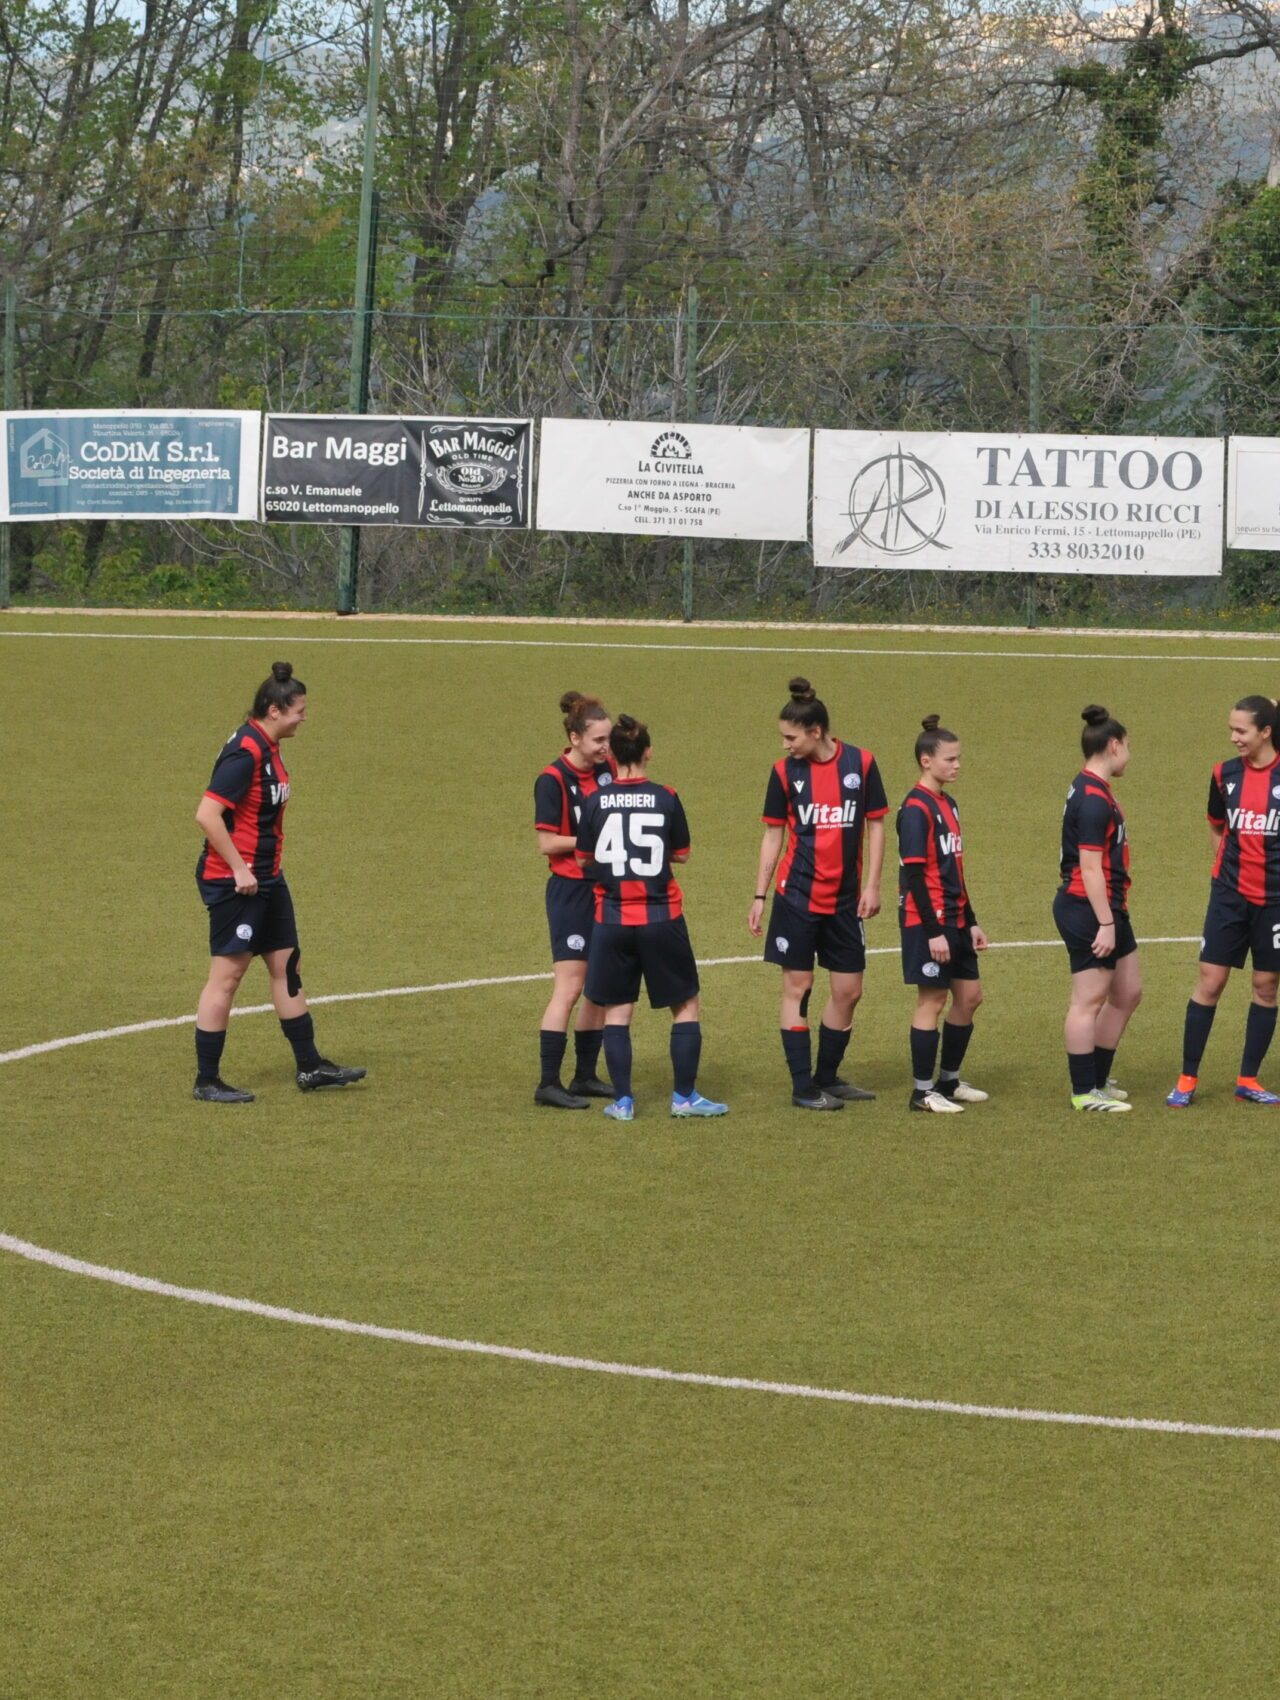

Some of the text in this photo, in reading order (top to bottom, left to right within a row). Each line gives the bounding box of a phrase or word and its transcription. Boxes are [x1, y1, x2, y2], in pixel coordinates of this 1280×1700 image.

[80, 441, 220, 462] CoDiM S.r.l.
[272, 435, 407, 466] Bar Maggi
[429, 437, 461, 459] BAR
[452, 452, 493, 462] OLD TIME
[69, 465, 231, 482] Società di Ingegneria
[638, 460, 704, 475] LA CIVITELLA
[976, 447, 1203, 492] TATTOO
[265, 485, 362, 497] c.so V. Emanuele
[606, 477, 633, 485] PIZZERIA
[635, 478, 648, 486] CON
[650, 479, 671, 487] FORNO
[679, 480, 699, 488] LEGNA
[705, 481, 736, 490] BRACERIA
[627, 490, 712, 502] ANCHE DA ASPORTO
[265, 501, 400, 516] 65020 Lettomanoppello
[429, 499, 513, 516] Lettomanoppello
[684, 506, 706, 515] SCAFA
[707, 507, 721, 517] (PE)
[974, 499, 1202, 524] DI ALESSIO RICCI
[634, 515, 650, 524] CELL.
[653, 516, 666, 524] 371
[668, 517, 676, 525] 31
[678, 517, 687, 526] 01
[974, 523, 992, 535] Via
[995, 524, 1031, 536] Enrico
[1034, 525, 1070, 537] Fermi,
[1073, 526, 1085, 537] 15
[1095, 527, 1174, 541] Lettomappello
[1176, 528, 1202, 541] (PE)
[1028, 541, 1145, 561] 333 8032010
[600, 793, 656, 810] BARBIERI
[797, 799, 857, 826] Vitali
[594, 812, 665, 877] 45
